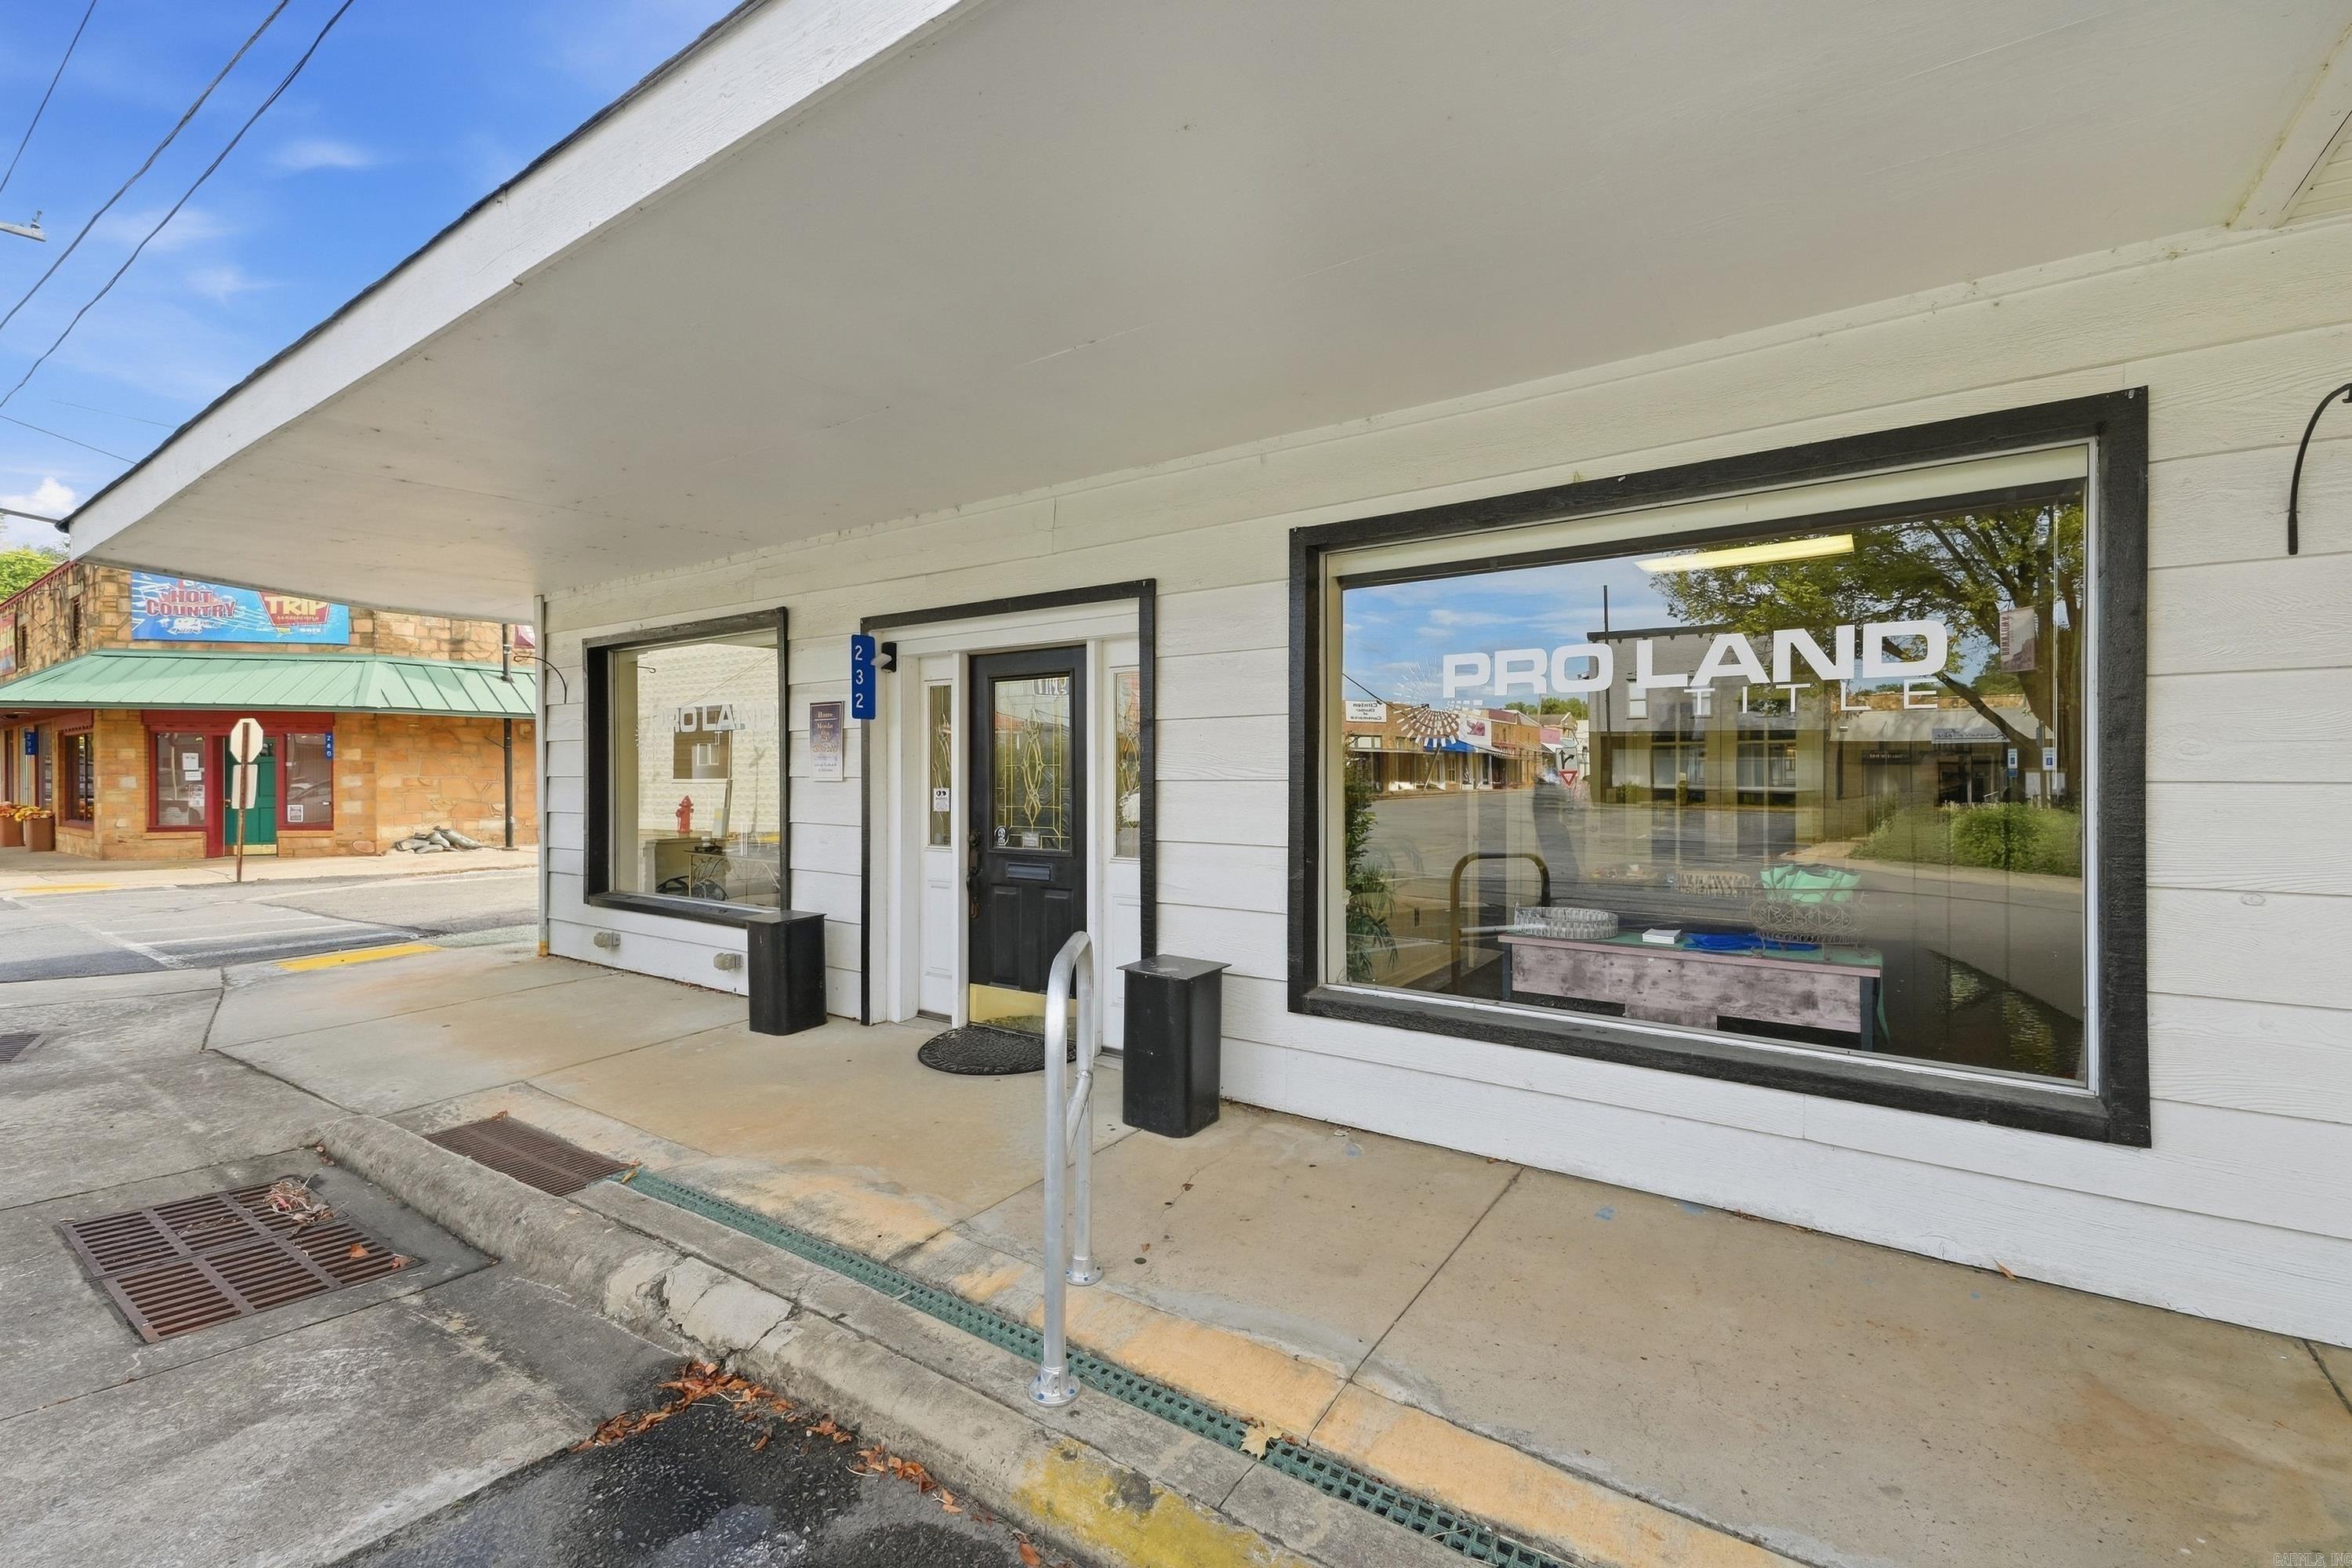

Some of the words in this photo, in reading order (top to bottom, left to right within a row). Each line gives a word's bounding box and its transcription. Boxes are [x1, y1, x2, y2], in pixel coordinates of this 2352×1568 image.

[146, 599, 237, 618] COUNTRY
[169, 590, 213, 604] HOT
[263, 595, 328, 616] TRIP
[1443, 643, 1613, 699] PRO
[1636, 620, 1948, 689] LAND
[855, 645, 864, 708] 232
[1683, 678, 1939, 716] TITLE
